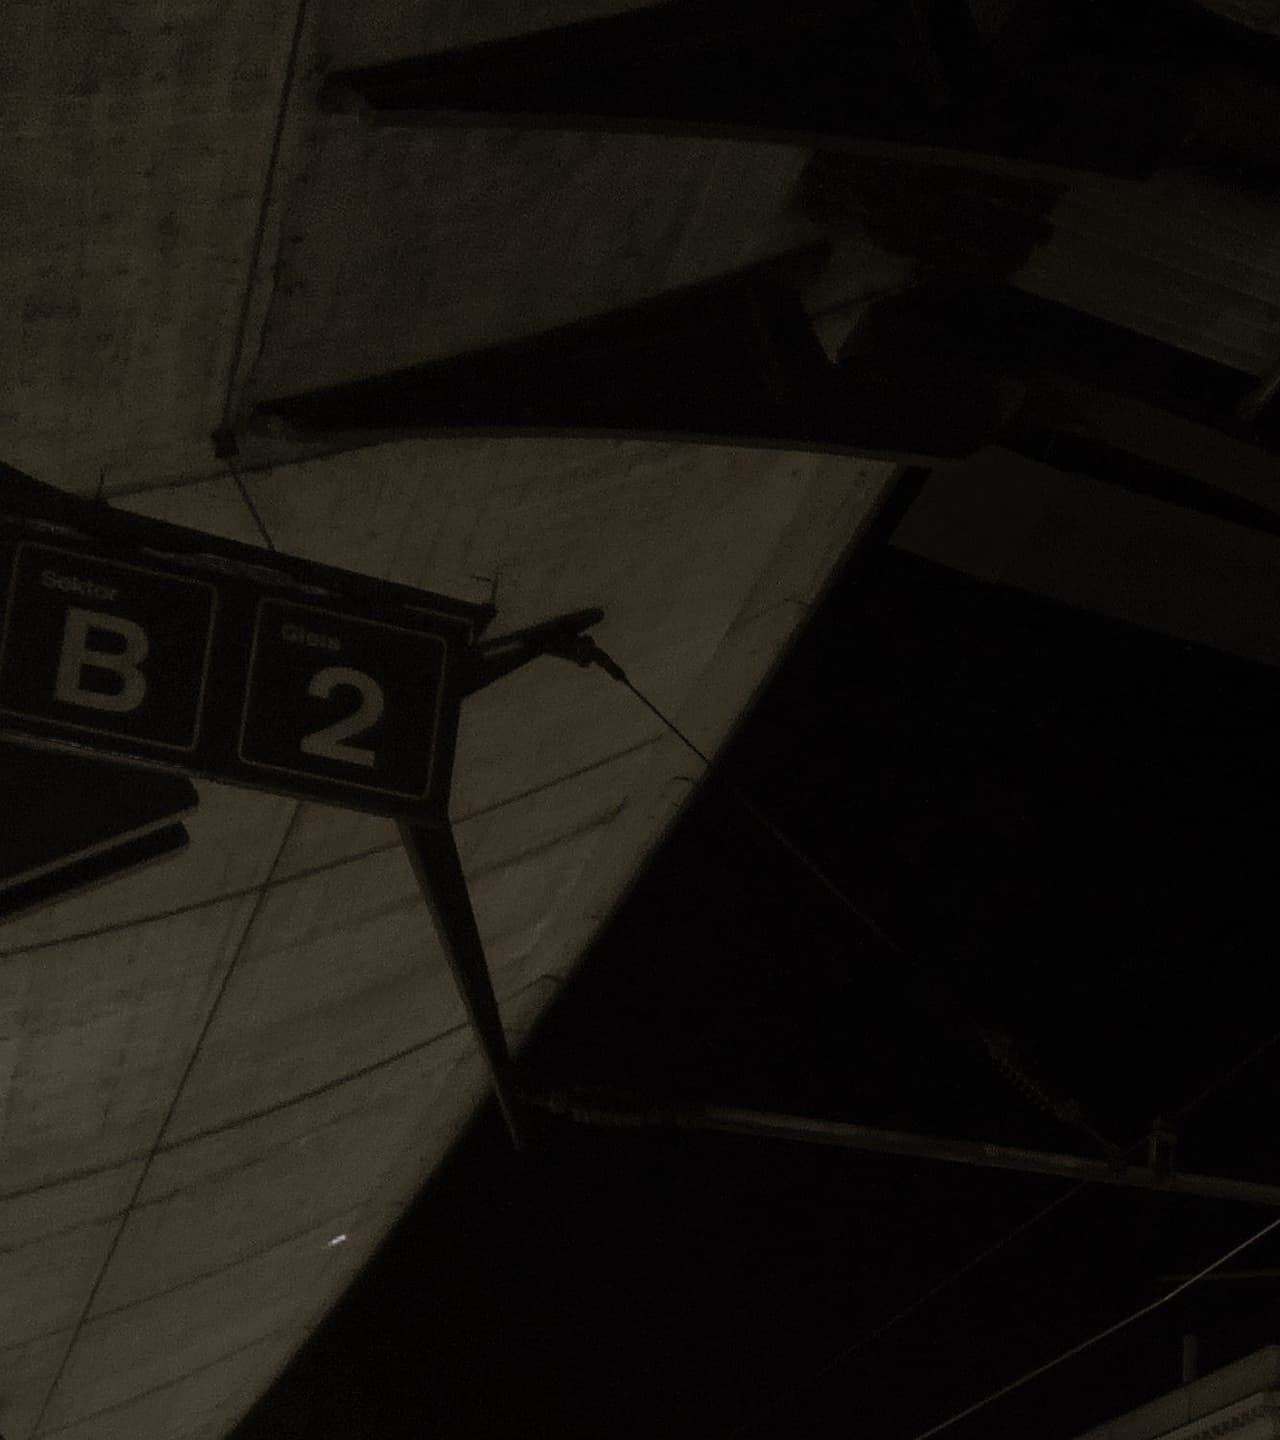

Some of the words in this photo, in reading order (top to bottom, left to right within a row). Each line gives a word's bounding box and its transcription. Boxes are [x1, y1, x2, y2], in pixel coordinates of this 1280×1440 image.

[39, 569, 119, 601] Sektor
[53, 607, 151, 714] B
[280, 622, 342, 652] Gleis
[299, 665, 387, 769] 2
